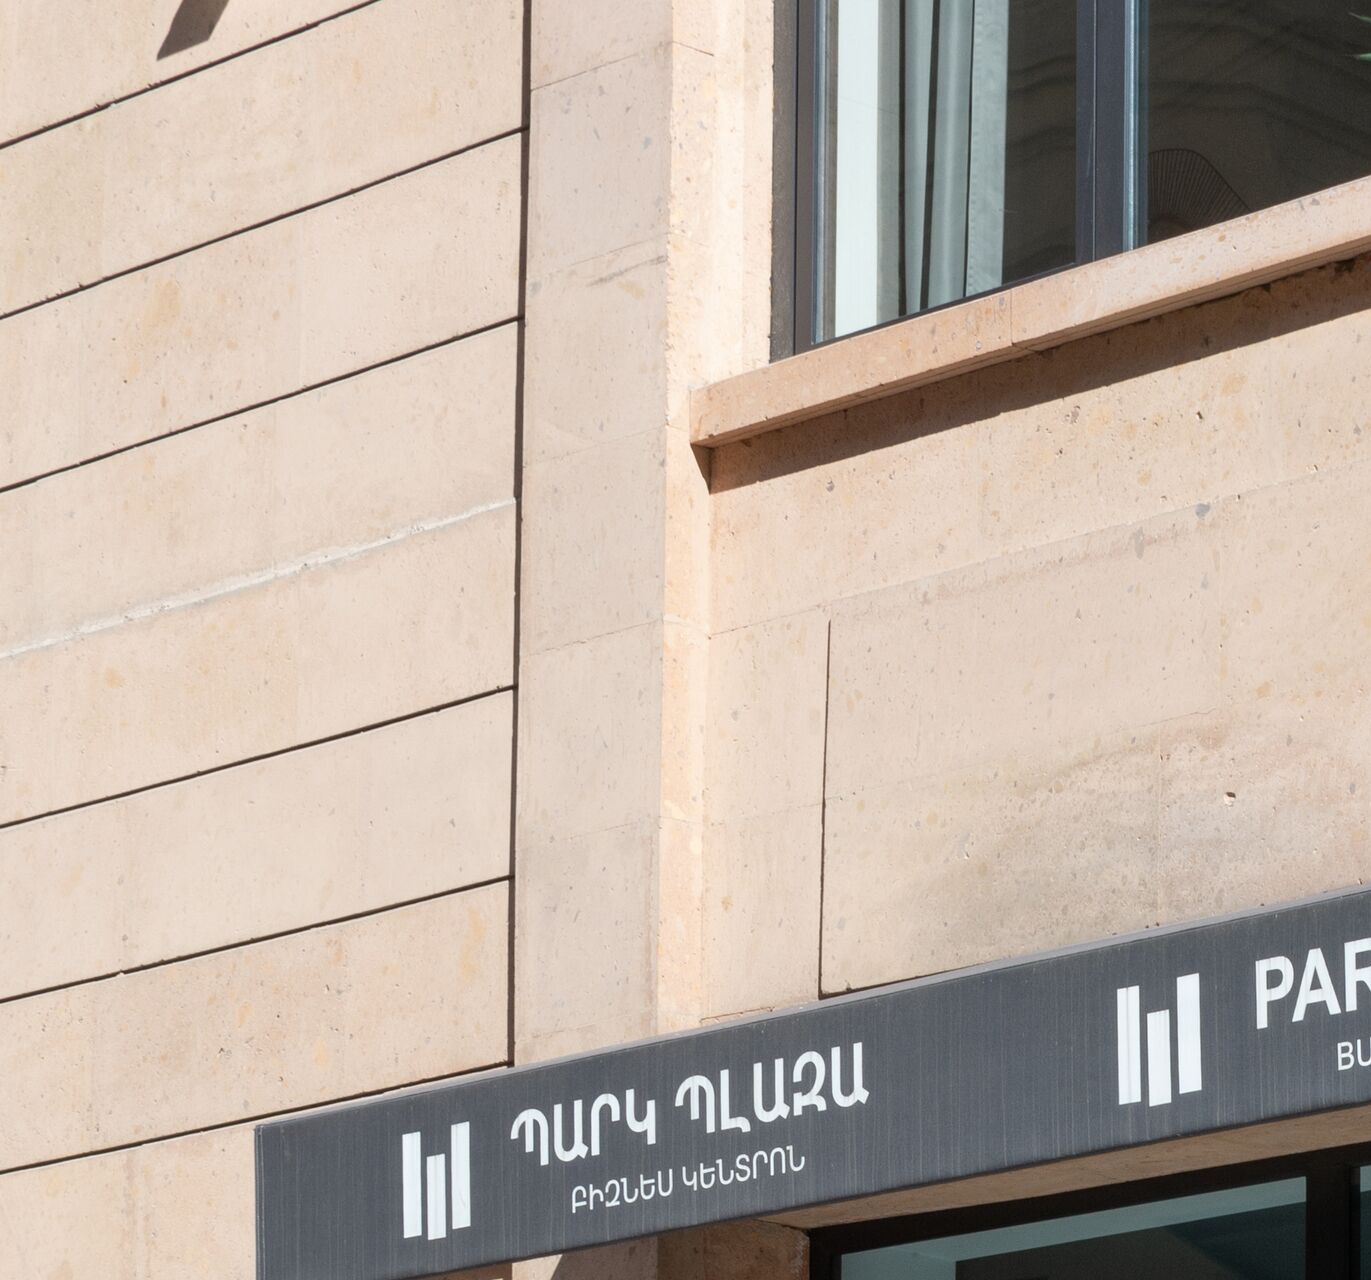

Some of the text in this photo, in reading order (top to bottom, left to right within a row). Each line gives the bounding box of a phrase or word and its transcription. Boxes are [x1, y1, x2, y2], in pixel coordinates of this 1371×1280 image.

[509, 1041, 871, 1167] ՊԱՐԿ ՊԼԱԶԱ
[570, 1143, 807, 1215] ԲԻԶՆԵՍ ԿԵՆՏՐՈՆ
